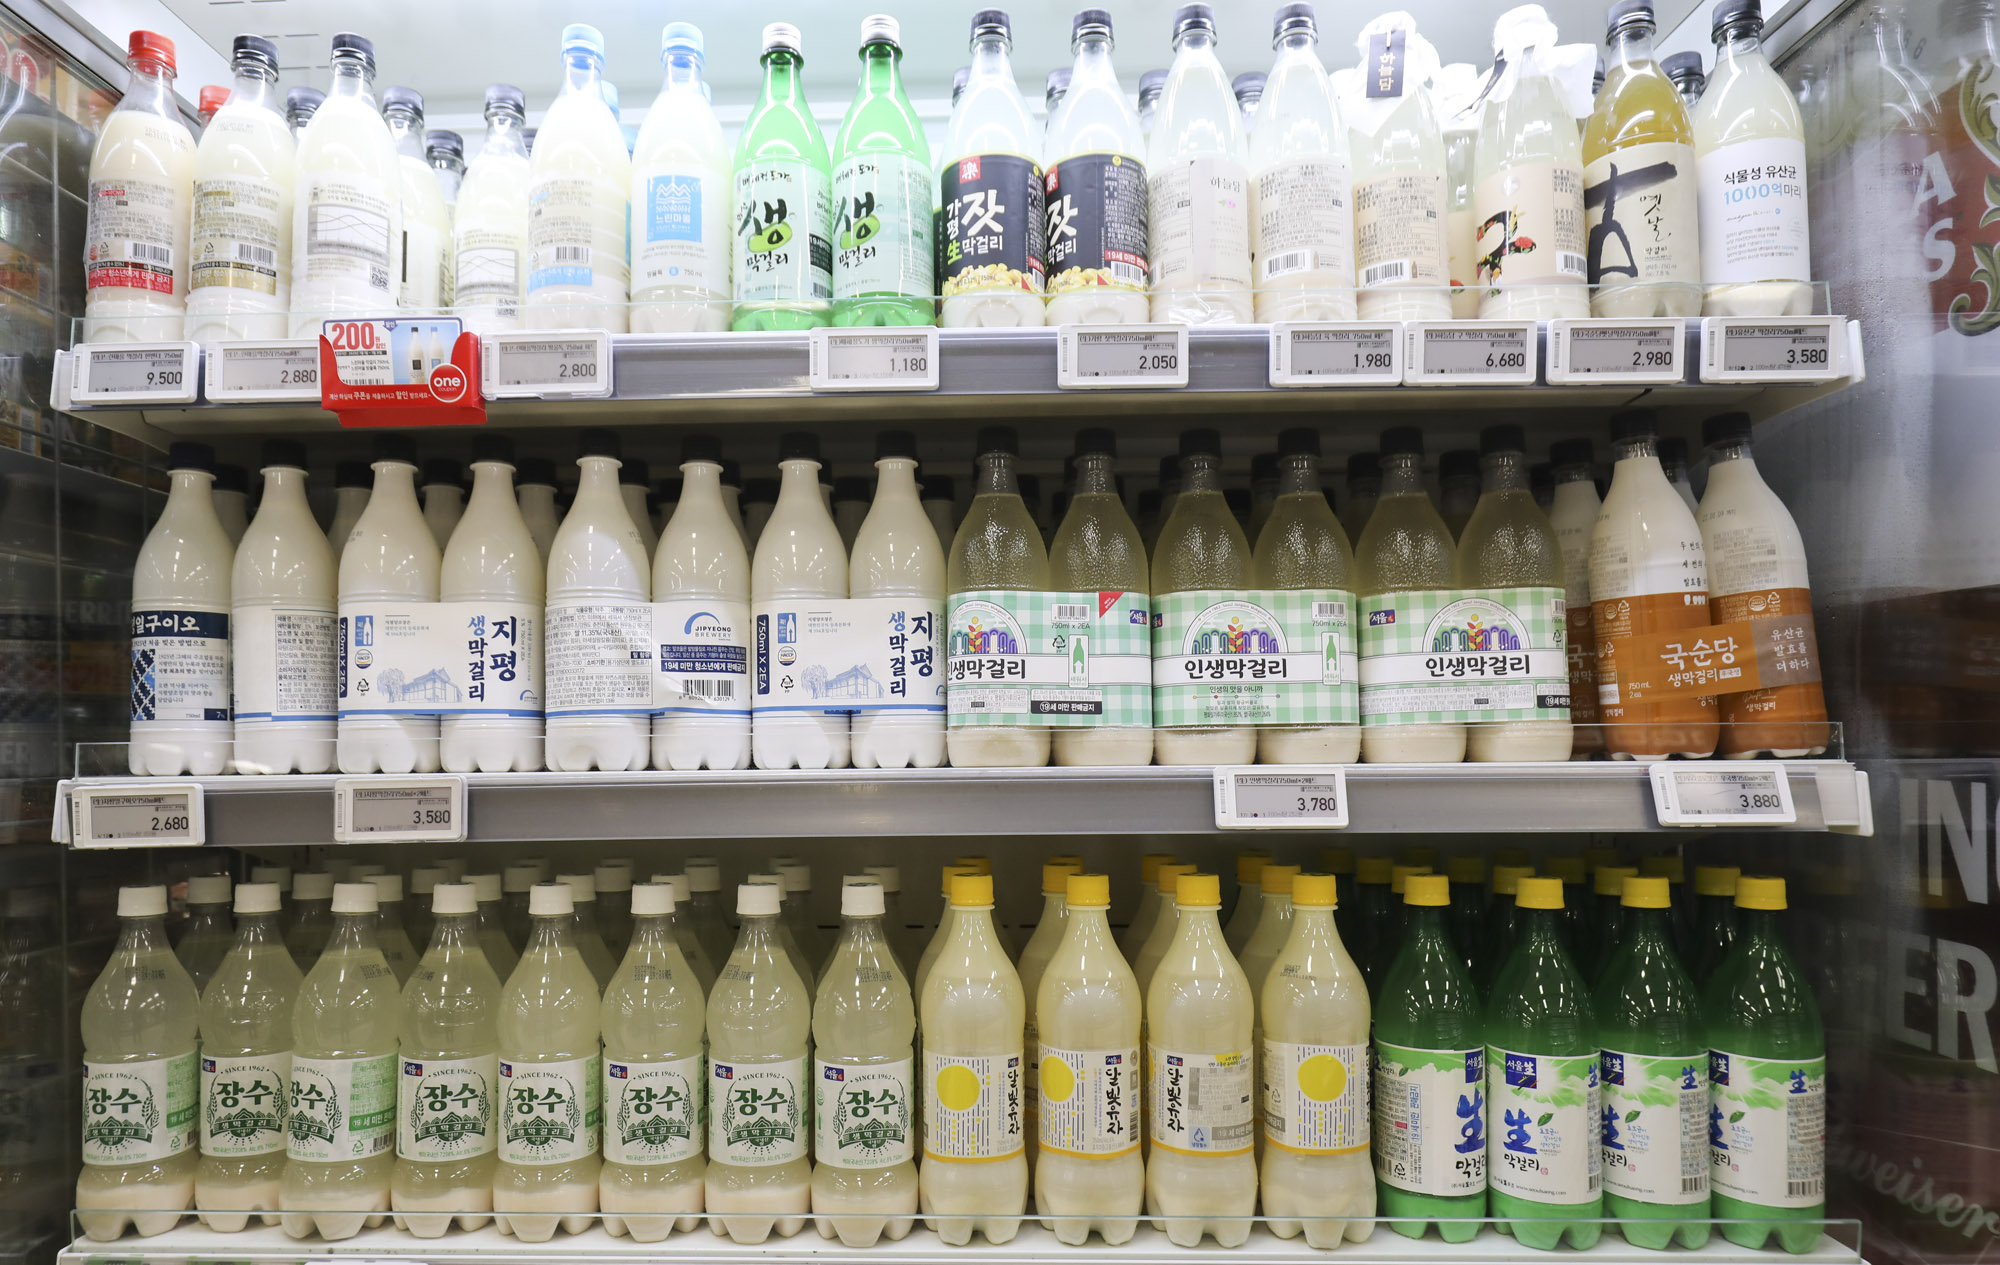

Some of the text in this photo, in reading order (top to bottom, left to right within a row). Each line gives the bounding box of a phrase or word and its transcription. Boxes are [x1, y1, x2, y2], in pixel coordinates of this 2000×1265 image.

[1723, 165, 1797, 185] 식물성 유산균
[1723, 183, 1802, 205] 1000억마리
[737, 198, 788, 245] 생
[834, 191, 876, 239] 생
[947, 198, 962, 241] 가평
[961, 189, 1005, 238] 잣
[1047, 194, 1079, 247] 잣
[747, 250, 788, 272] 막걸리
[839, 246, 876, 269] 막걸리
[332, 322, 374, 351] 200
[433, 376, 461, 388] one
[1371, 613, 1388, 625] 서울
[757, 619, 767, 654] 750ml
[910, 612, 933, 678] 지평
[1771, 627, 1804, 641] 유산균
[468, 615, 488, 703] 생막걸리
[489, 616, 518, 682] 지평
[888, 611, 908, 698] 생막걸리
[1660, 636, 1739, 671] 국순당
[1774, 642, 1807, 657] 발효를
[664, 661, 679, 671] 19세
[679, 661, 693, 671] 미만
[694, 661, 726, 671] 청소년에게
[948, 658, 1026, 681] 인생막걸리
[1185, 658, 1287, 679] 인생막걸리
[1425, 655, 1530, 677] 인생막걸리
[757, 667, 767, 690] 2EA
[1209, 685, 1263, 693] 인생의 맛을 아니까
[1667, 668, 1718, 688] 생막걸리
[1057, 703, 1070, 711] 미만
[1071, 703, 1095, 711] 판매금지
[1746, 700, 1776, 712] 생막걸리
[224, 1066, 247, 1074] SINCE
[306, 1067, 320, 1076] 1962
[433, 1069, 455, 1077] SINCE
[638, 1071, 660, 1079] SINCE
[743, 1073, 764, 1081] SINCE
[855, 1074, 877, 1082] SINCE
[1506, 1060, 1536, 1076] 서울生
[88, 1088, 142, 1115] 장수
[217, 1080, 273, 1108] 장수
[290, 1080, 326, 1110] 장수
[423, 1083, 479, 1111] 장수
[512, 1087, 566, 1114] 장수
[628, 1086, 683, 1114] 장수
[734, 1087, 788, 1115] 장수
[845, 1089, 898, 1117] 장수
[1007, 1069, 1020, 1135] 달빛유자
[1105, 1067, 1123, 1135] 달빛유자
[1167, 1068, 1184, 1133] 달빛유자
[1503, 1108, 1537, 1154] 生
[1504, 1153, 1539, 1172] 막걸리
